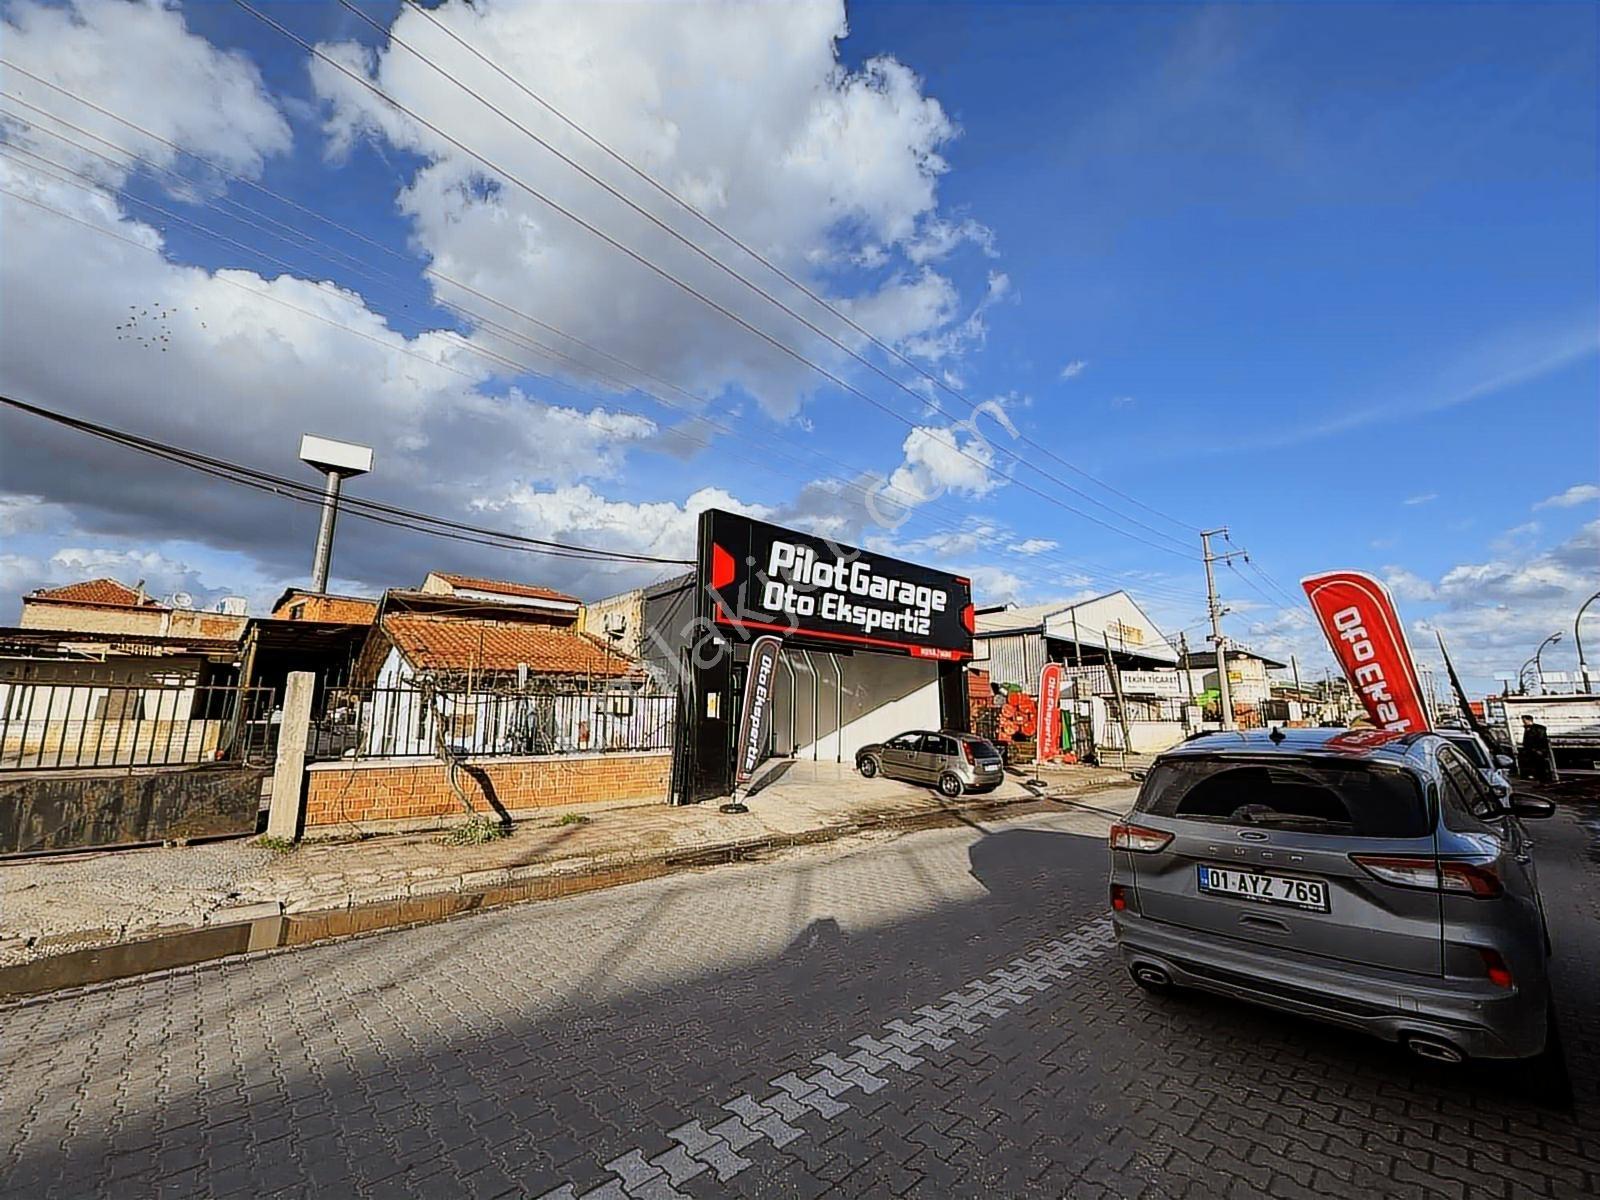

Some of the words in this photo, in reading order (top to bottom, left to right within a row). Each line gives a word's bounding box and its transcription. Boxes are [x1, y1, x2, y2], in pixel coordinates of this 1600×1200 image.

[767, 540, 947, 617] PilotGarage
[763, 580, 815, 616] Oto
[821, 592, 931, 635] Ekspertiz
[758, 654, 773, 686] Oto
[1210, 870, 1228, 890] 01
[1238, 874, 1273, 897] AYZ
[1282, 880, 1321, 903] 769
